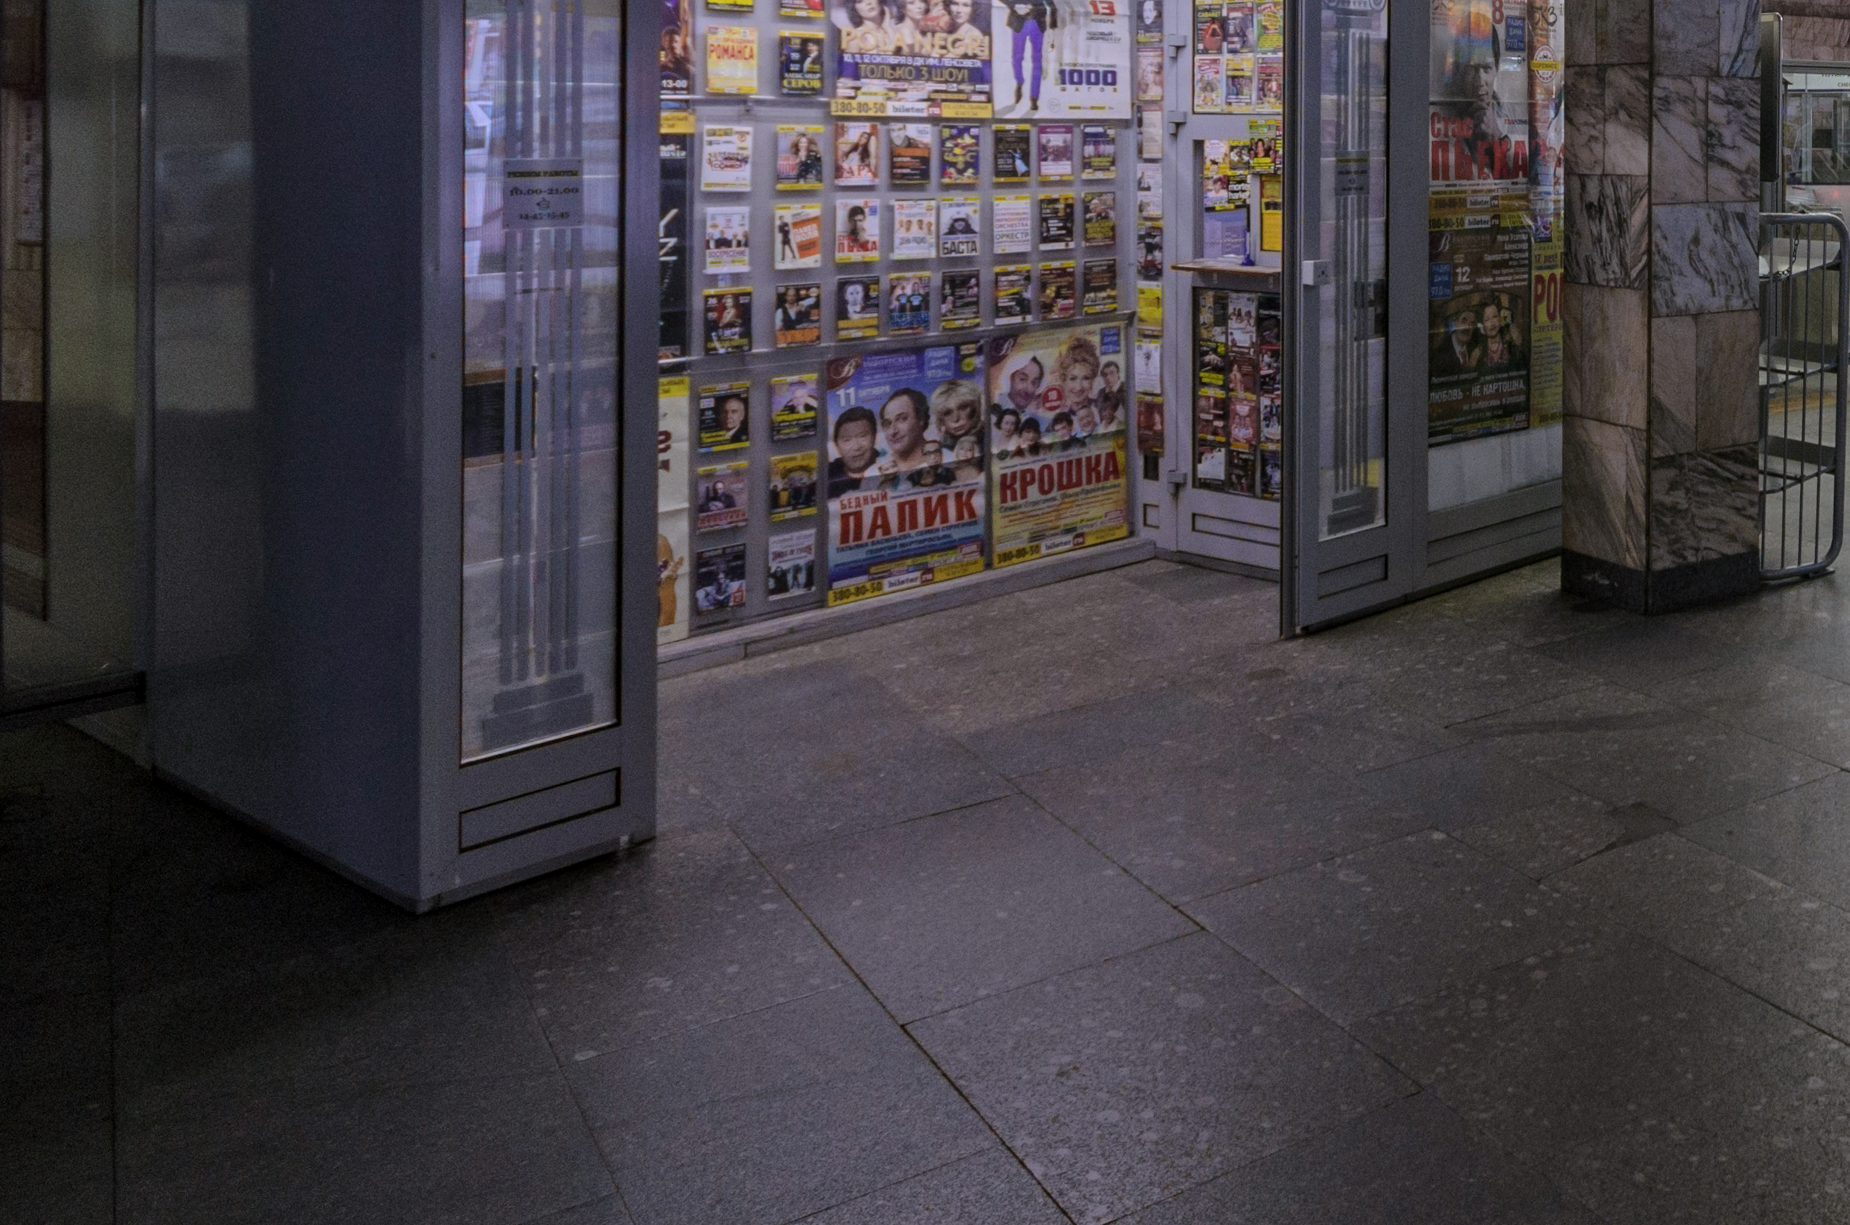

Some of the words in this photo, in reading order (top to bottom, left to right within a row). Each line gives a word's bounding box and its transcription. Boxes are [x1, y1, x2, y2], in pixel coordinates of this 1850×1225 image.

[1088, 0, 1117, 16] 13
[840, 27, 909, 53] POLA
[913, 31, 991, 58] NEGRI
[708, 43, 755, 62] РОМАНСА
[872, 54, 906, 64] ОКТЯБРЯ
[939, 59, 983, 68] ЛЕНСОВЕТА
[859, 63, 917, 80] ТОЛЬКО
[919, 65, 930, 81] 3
[931, 67, 970, 82] ШОУ!
[1059, 68, 1117, 86] 1000
[832, 101, 887, 114] 380-80-50
[891, 102, 926, 113] bileter
[1430, 111, 1474, 139] Стас
[1431, 140, 1529, 182] ПЬЕХА
[1467, 217, 1491, 227] bileter
[995, 232, 1030, 240] ОРКЕСТР
[941, 240, 979, 256] БАСТА
[1455, 266, 1471, 283] 12
[835, 386, 856, 407] 11
[1428, 390, 1464, 404] ЛЮБОВЬ
[1471, 385, 1482, 398] НЕ
[1482, 380, 1526, 398] КАРТОШКА,
[1000, 451, 1121, 505] КРОШКА
[839, 489, 889, 511] БЕДНЫЙ
[838, 488, 979, 546] ПАПИК
